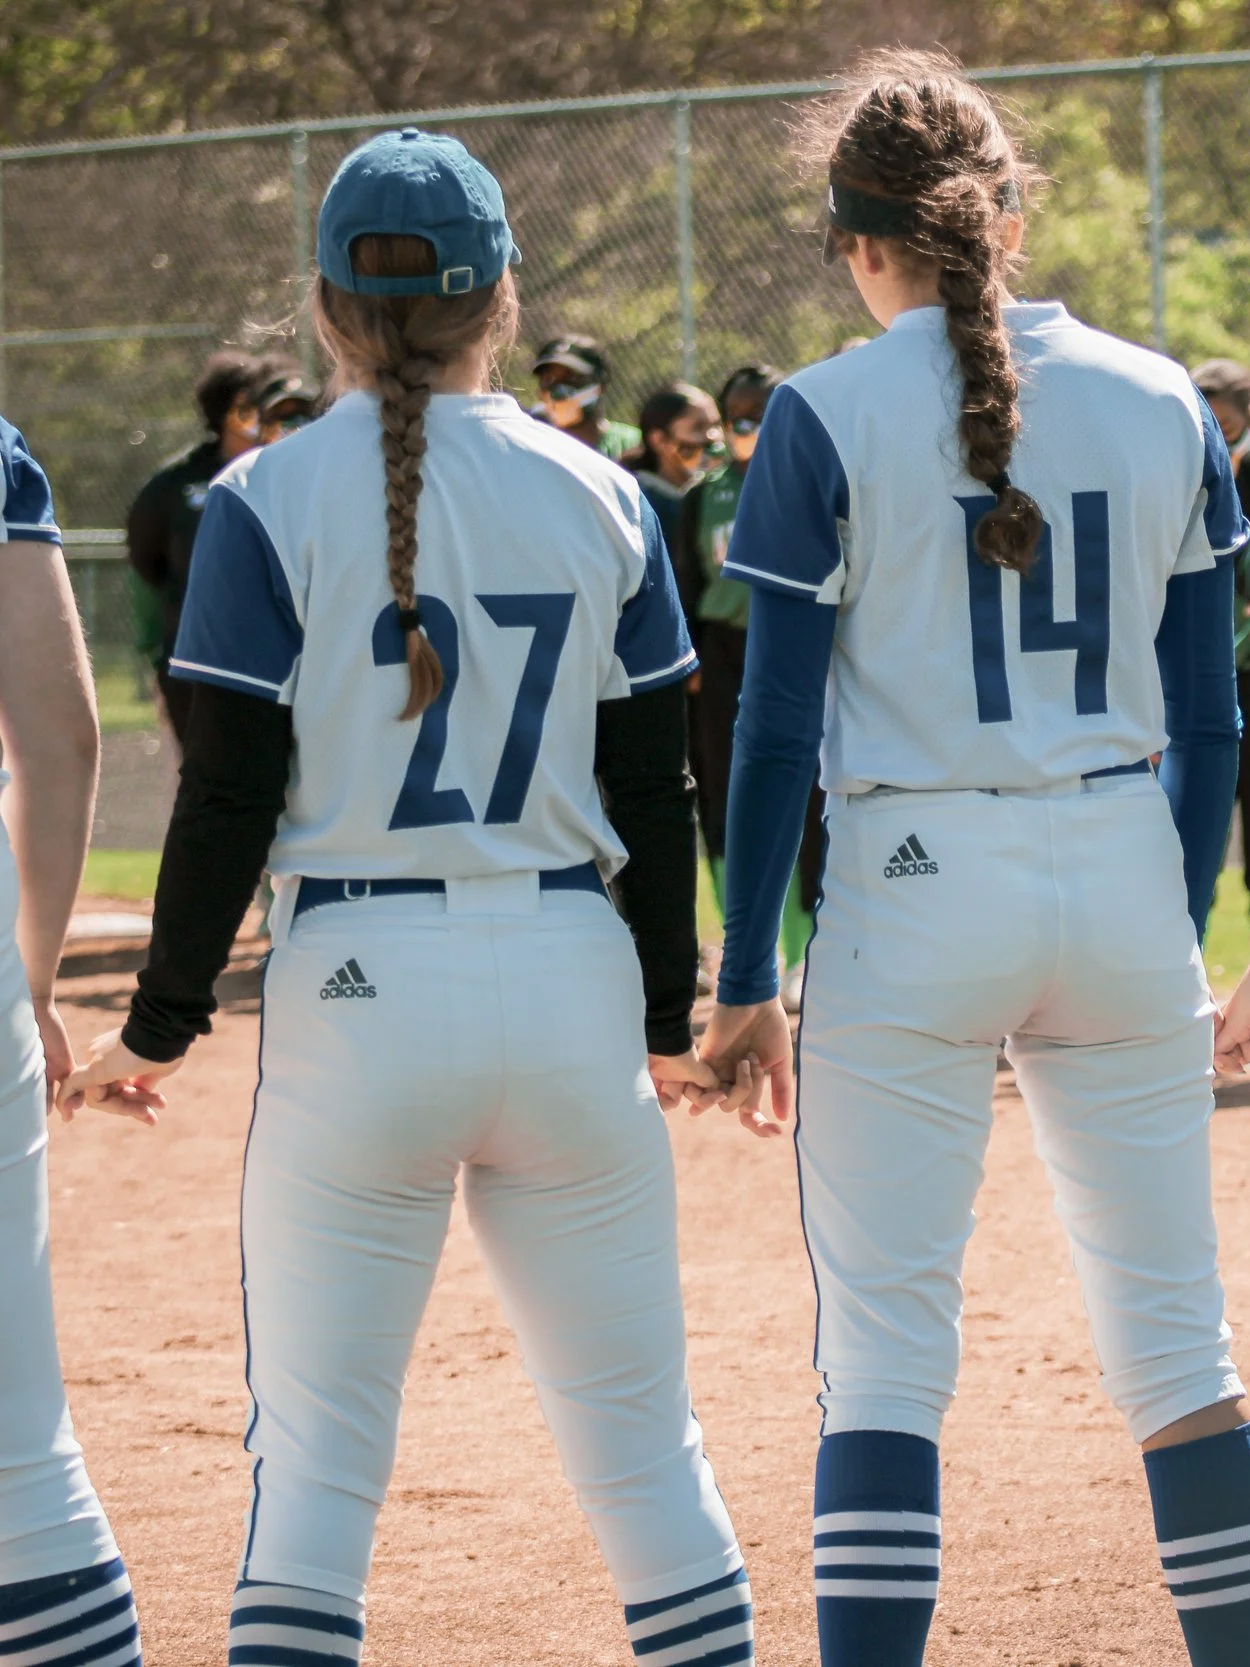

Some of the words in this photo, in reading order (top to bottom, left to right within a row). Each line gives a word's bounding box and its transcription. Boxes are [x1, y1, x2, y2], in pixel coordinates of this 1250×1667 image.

[953, 491, 1110, 723] 14
[372, 592, 576, 831] 27
[884, 860, 939, 879] adidas
[320, 984, 377, 1000] adidas
